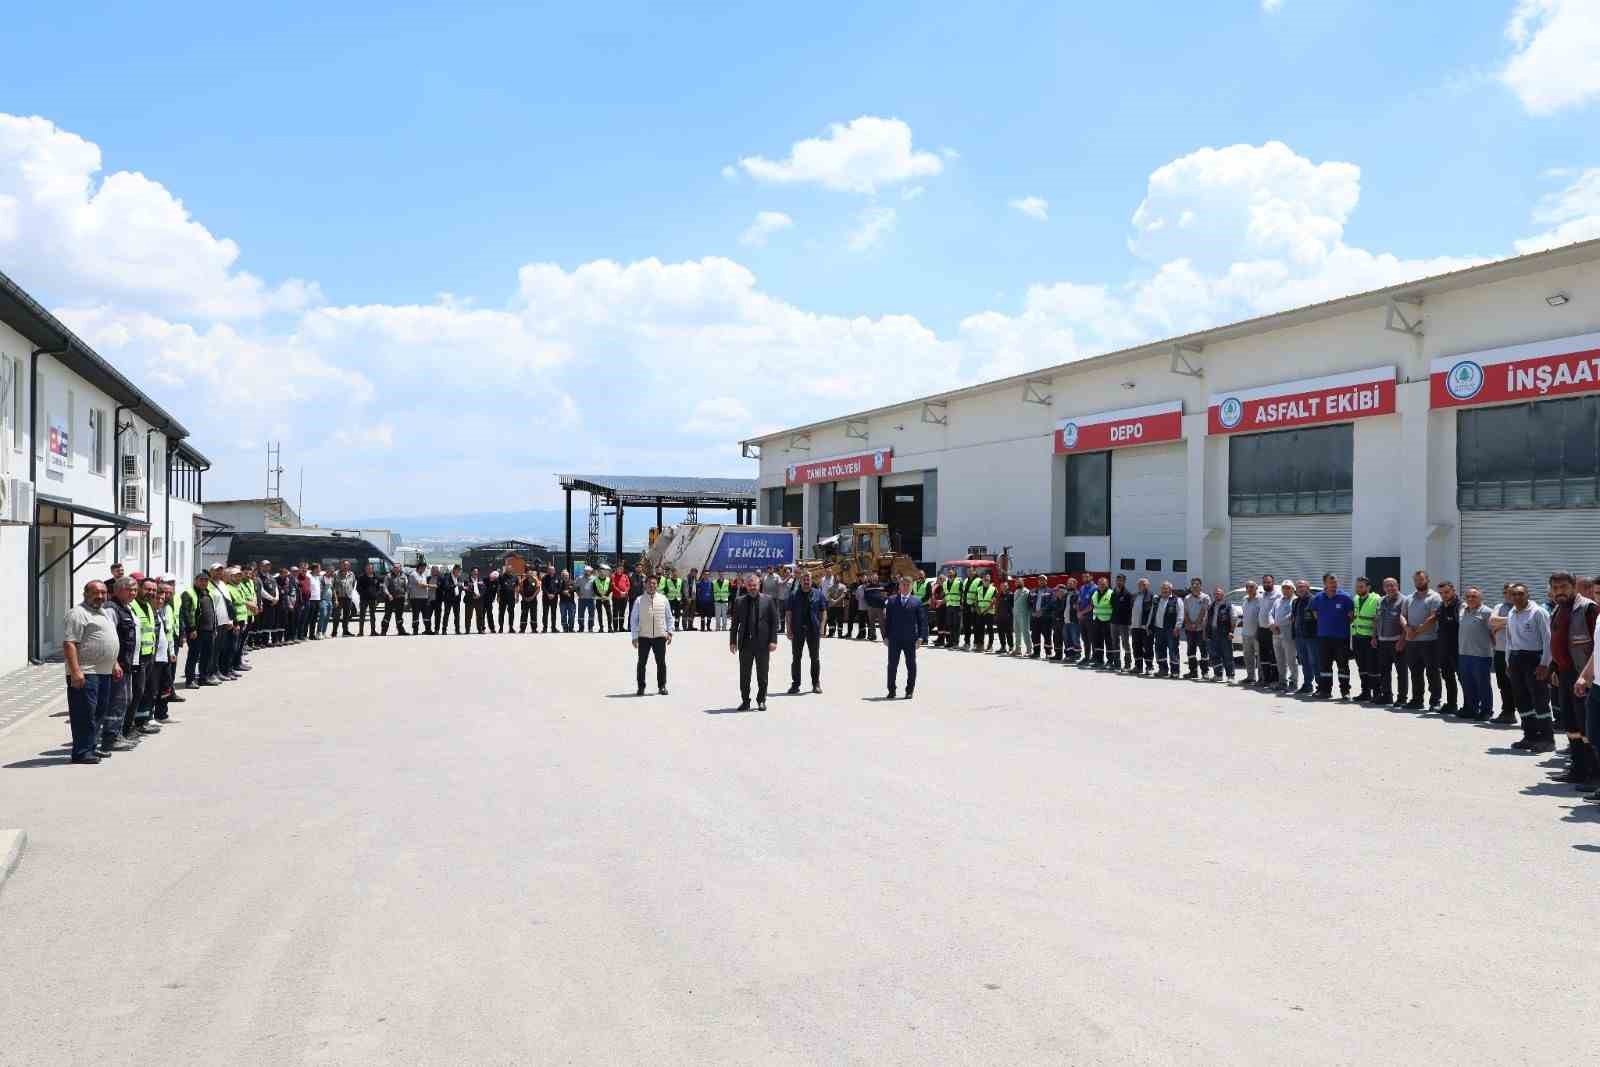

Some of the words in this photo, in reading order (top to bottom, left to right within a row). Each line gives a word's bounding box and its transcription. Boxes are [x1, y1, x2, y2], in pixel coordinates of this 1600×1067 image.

[1255, 398, 1321, 424] ASFALT
[1325, 385, 1380, 414] EKİBİ
[1110, 423, 1143, 441] DEPO
